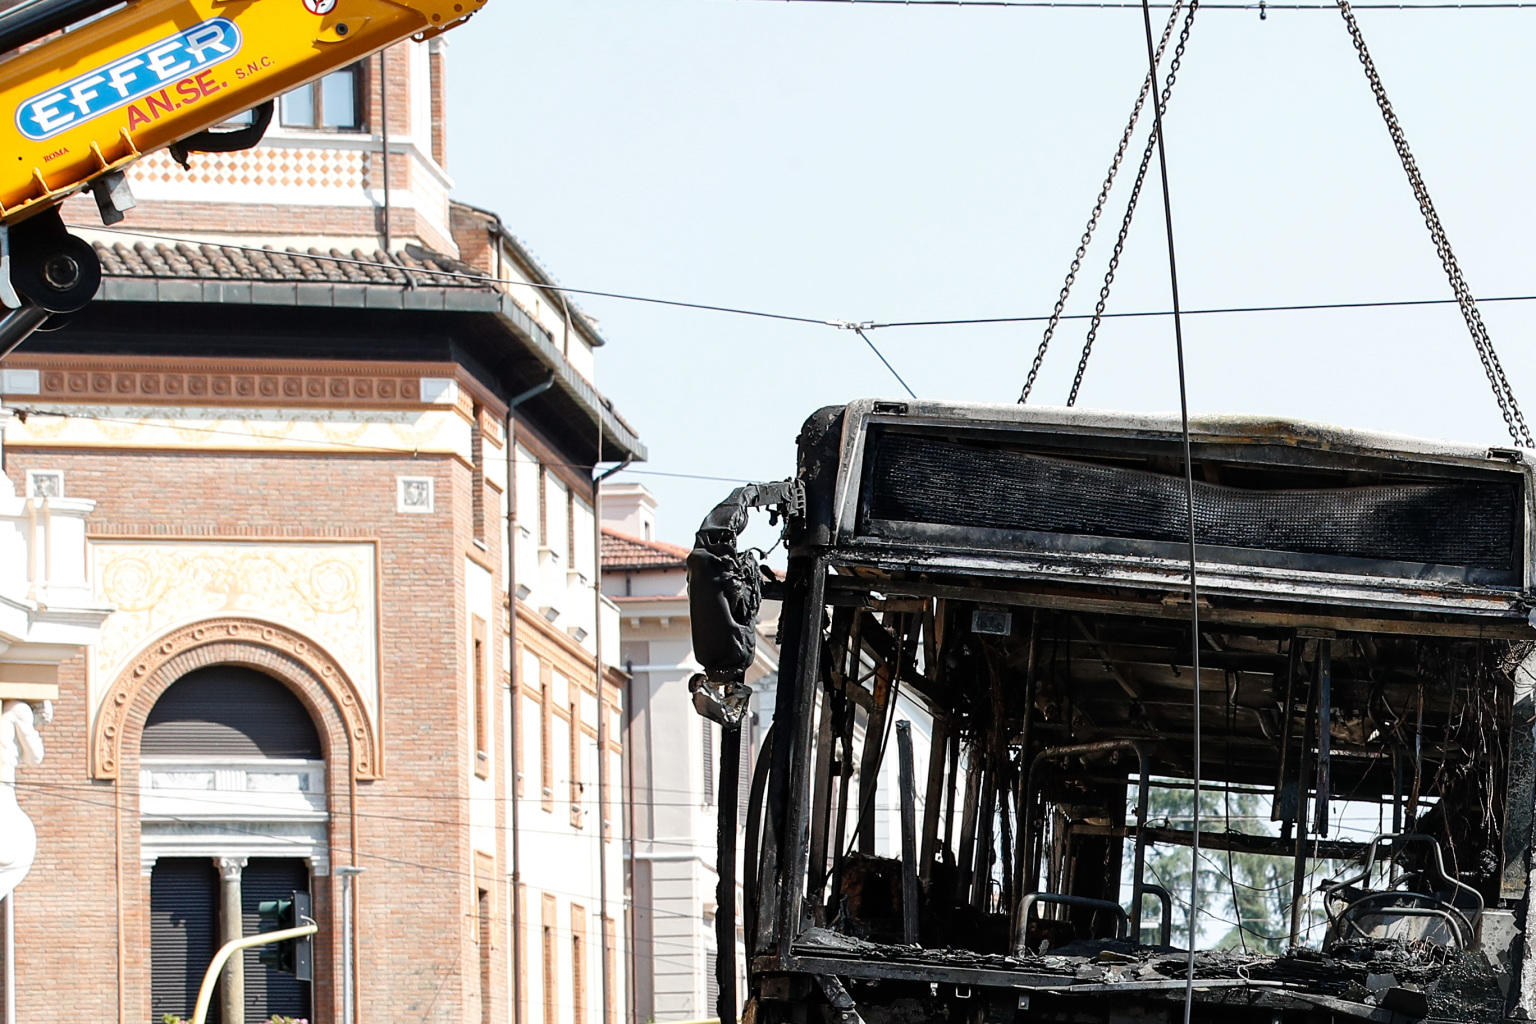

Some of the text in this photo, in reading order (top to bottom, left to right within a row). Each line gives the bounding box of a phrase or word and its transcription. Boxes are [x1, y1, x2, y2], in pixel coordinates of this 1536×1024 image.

[30, 23, 232, 133] EFFER
[127, 55, 276, 132] AN.SE. S.N.C.
[43, 147, 70, 163] ROMA
